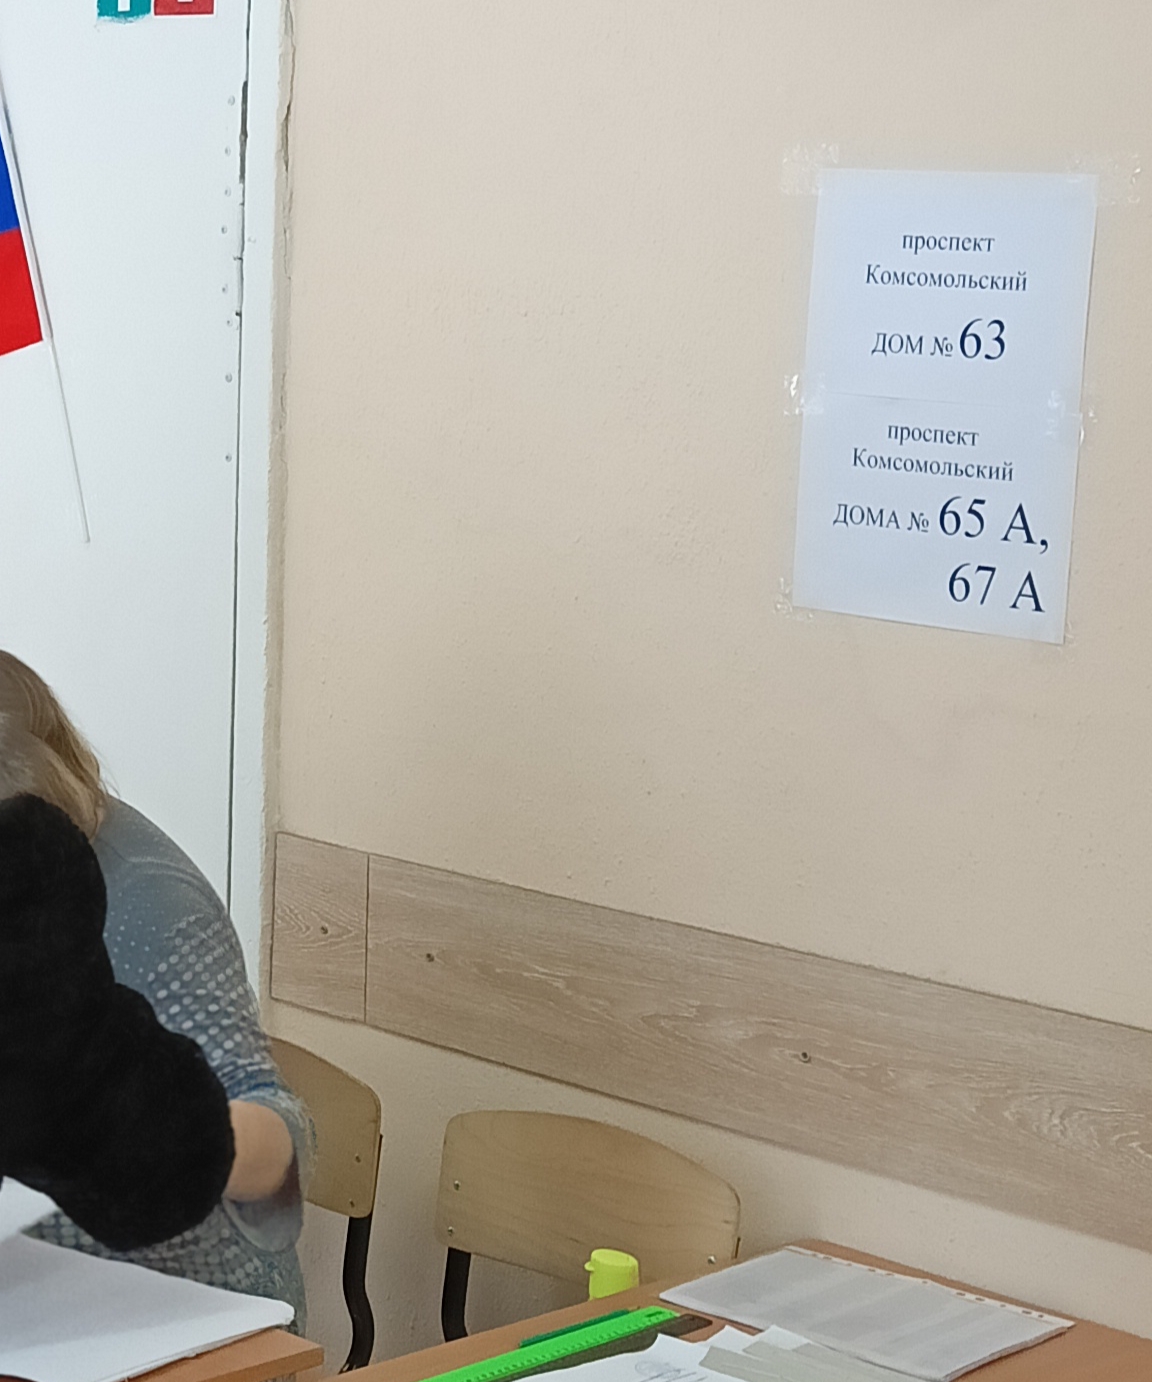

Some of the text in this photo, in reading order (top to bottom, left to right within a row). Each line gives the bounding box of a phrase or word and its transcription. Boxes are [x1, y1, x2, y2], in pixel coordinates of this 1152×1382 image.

[901, 233, 996, 255] проспект
[865, 263, 1028, 292] Комсомольский
[870, 332, 924, 356] ДОМ
[958, 317, 1007, 361] 63
[887, 423, 980, 447] проспект
[852, 446, 1014, 483] Комсомольский
[832, 502, 901, 531] ДОМА
[938, 495, 987, 538] 65
[1000, 502, 1050, 555] А,
[947, 562, 1046, 614] 67 А
